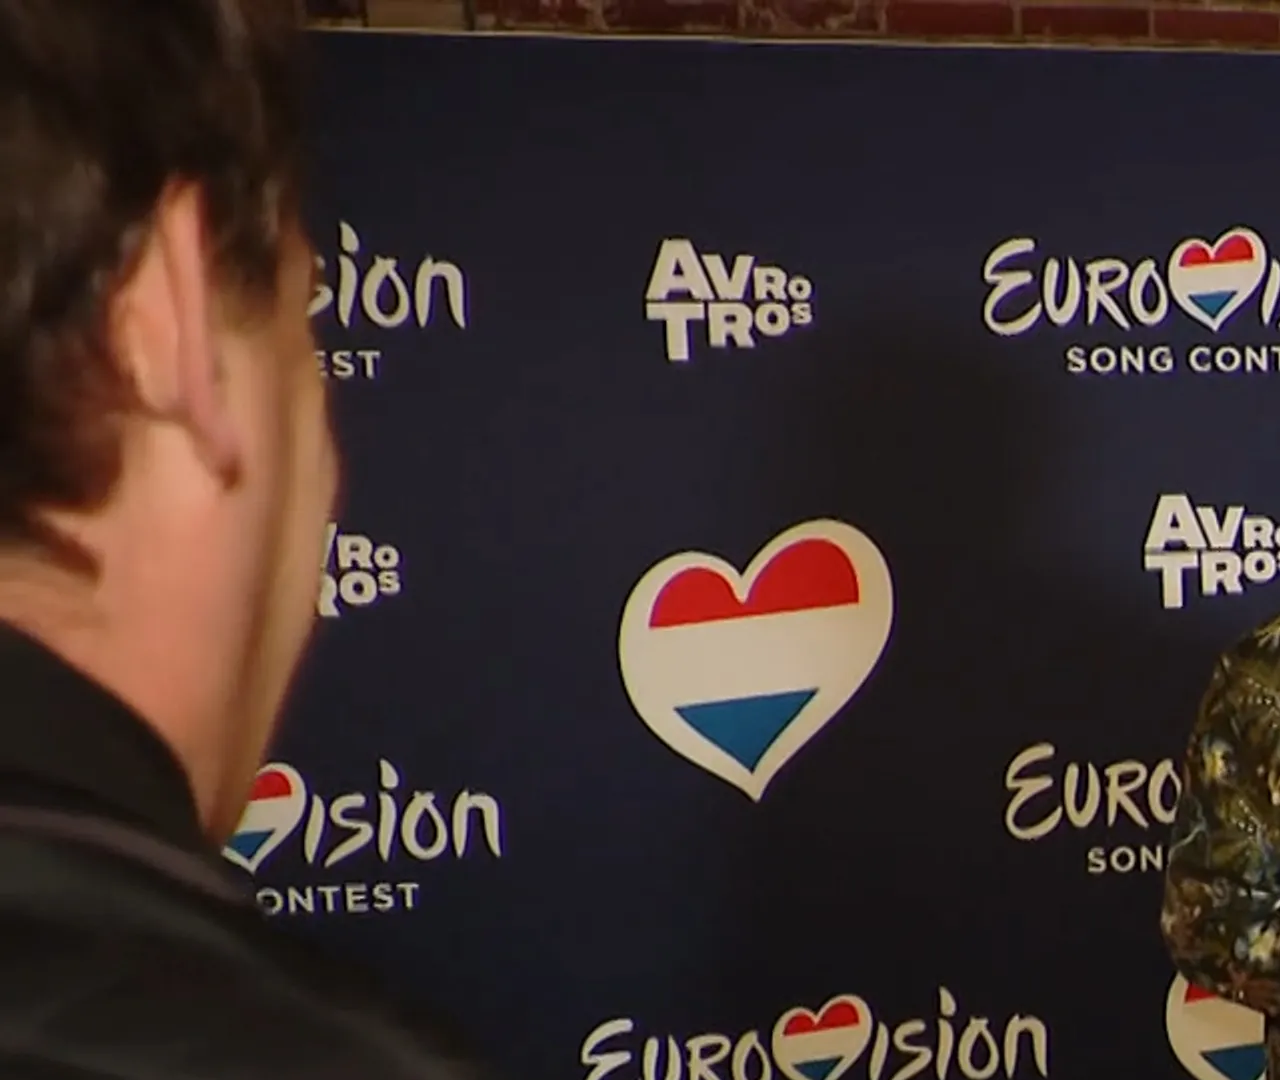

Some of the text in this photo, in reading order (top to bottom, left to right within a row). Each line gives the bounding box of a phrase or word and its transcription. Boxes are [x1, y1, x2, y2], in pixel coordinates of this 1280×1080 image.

[1067, 346, 1173, 373] SONG
[1087, 845, 1164, 874] SON
[256, 882, 419, 915] ONTEST
